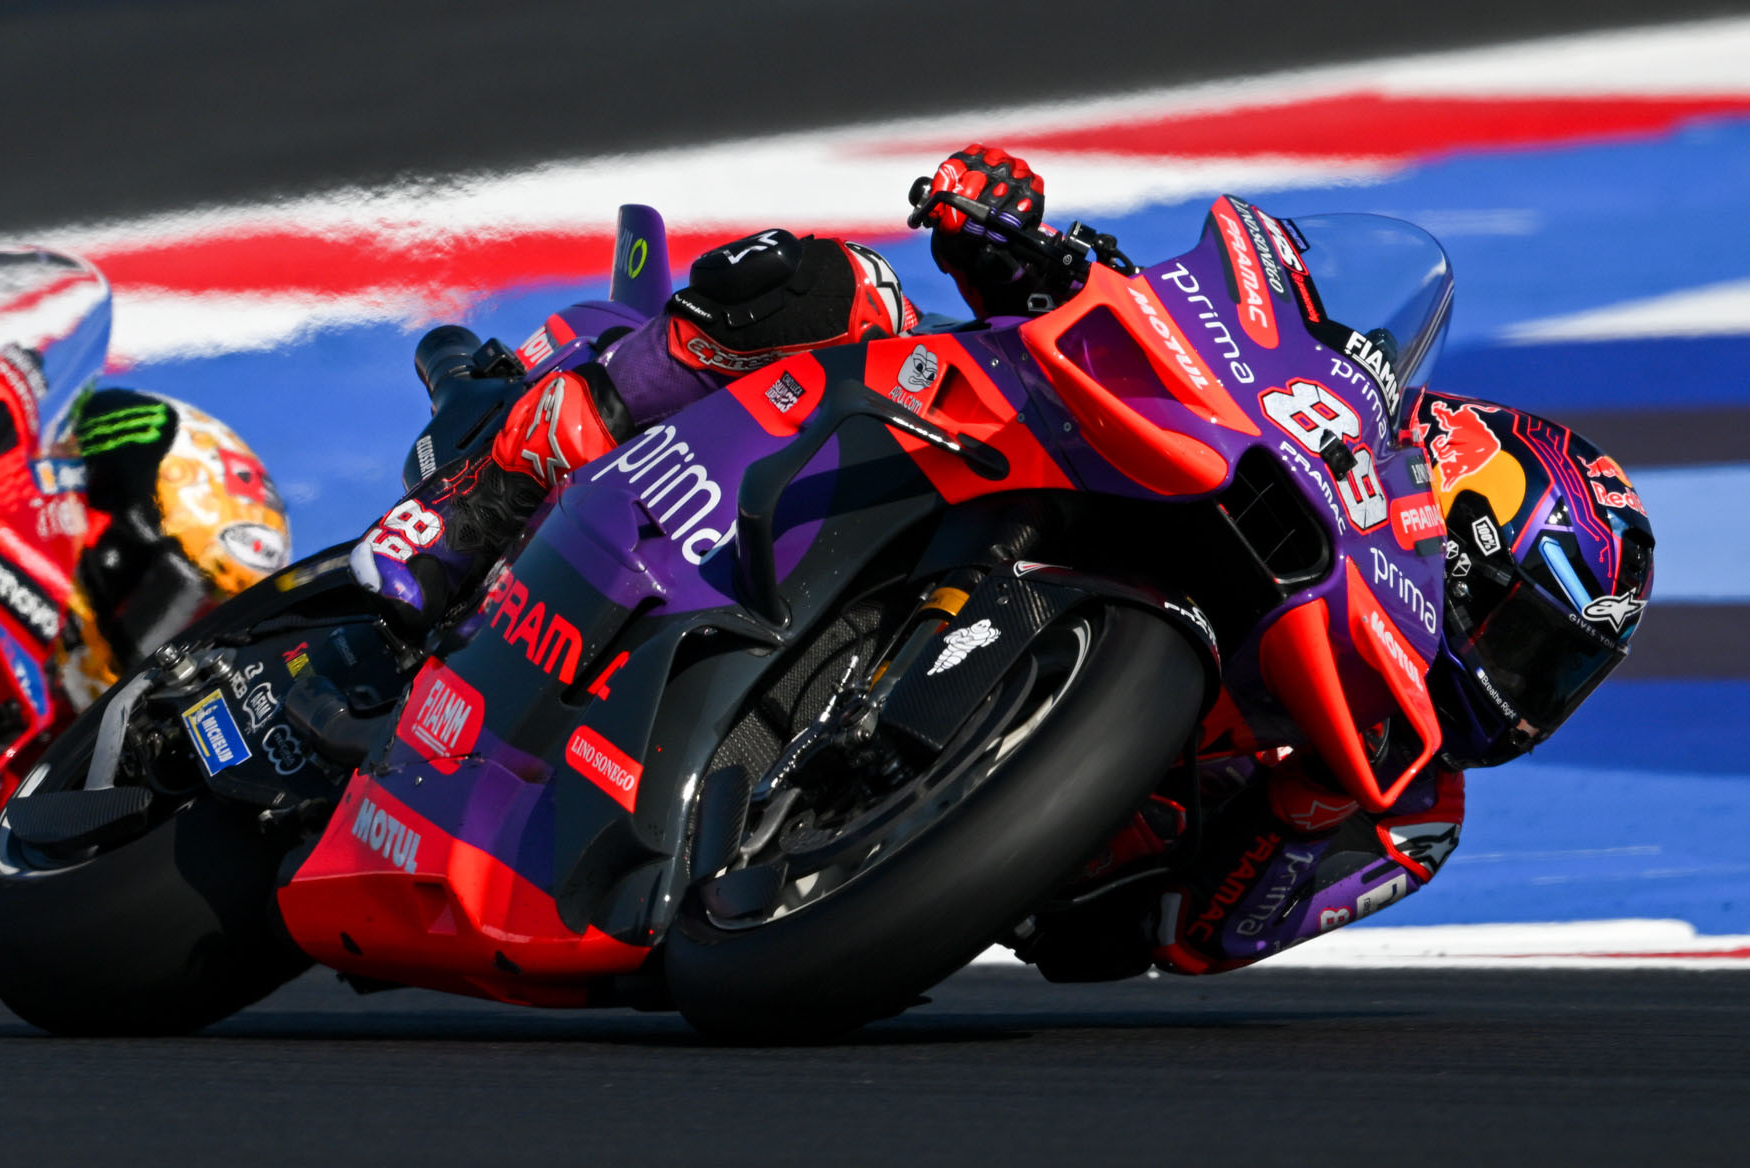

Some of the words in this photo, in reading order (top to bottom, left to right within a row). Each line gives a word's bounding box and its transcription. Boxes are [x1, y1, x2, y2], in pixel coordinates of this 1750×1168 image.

[1219, 213, 1267, 328] PRAMAC
[1128, 286, 1208, 390] MOTUL
[1162, 263, 1254, 383] prima
[1331, 358, 1386, 439] prima
[1345, 331, 1400, 416] FIAMM
[1258, 377, 1389, 532] 89
[1280, 441, 1346, 535] PRAMAC
[591, 425, 737, 566] prima
[1476, 522, 1496, 551] 100%
[1370, 547, 1436, 635] prima
[1568, 613, 1596, 637] GIVES
[1371, 611, 1423, 691] MOTUL
[1481, 674, 1503, 704] Breathe
[201, 714, 234, 763] MICHELIN
[417, 679, 472, 749] FIAMM
[570, 735, 596, 763] LINO
[591, 752, 635, 792] SONEGO
[351, 798, 422, 875] MOTUL
